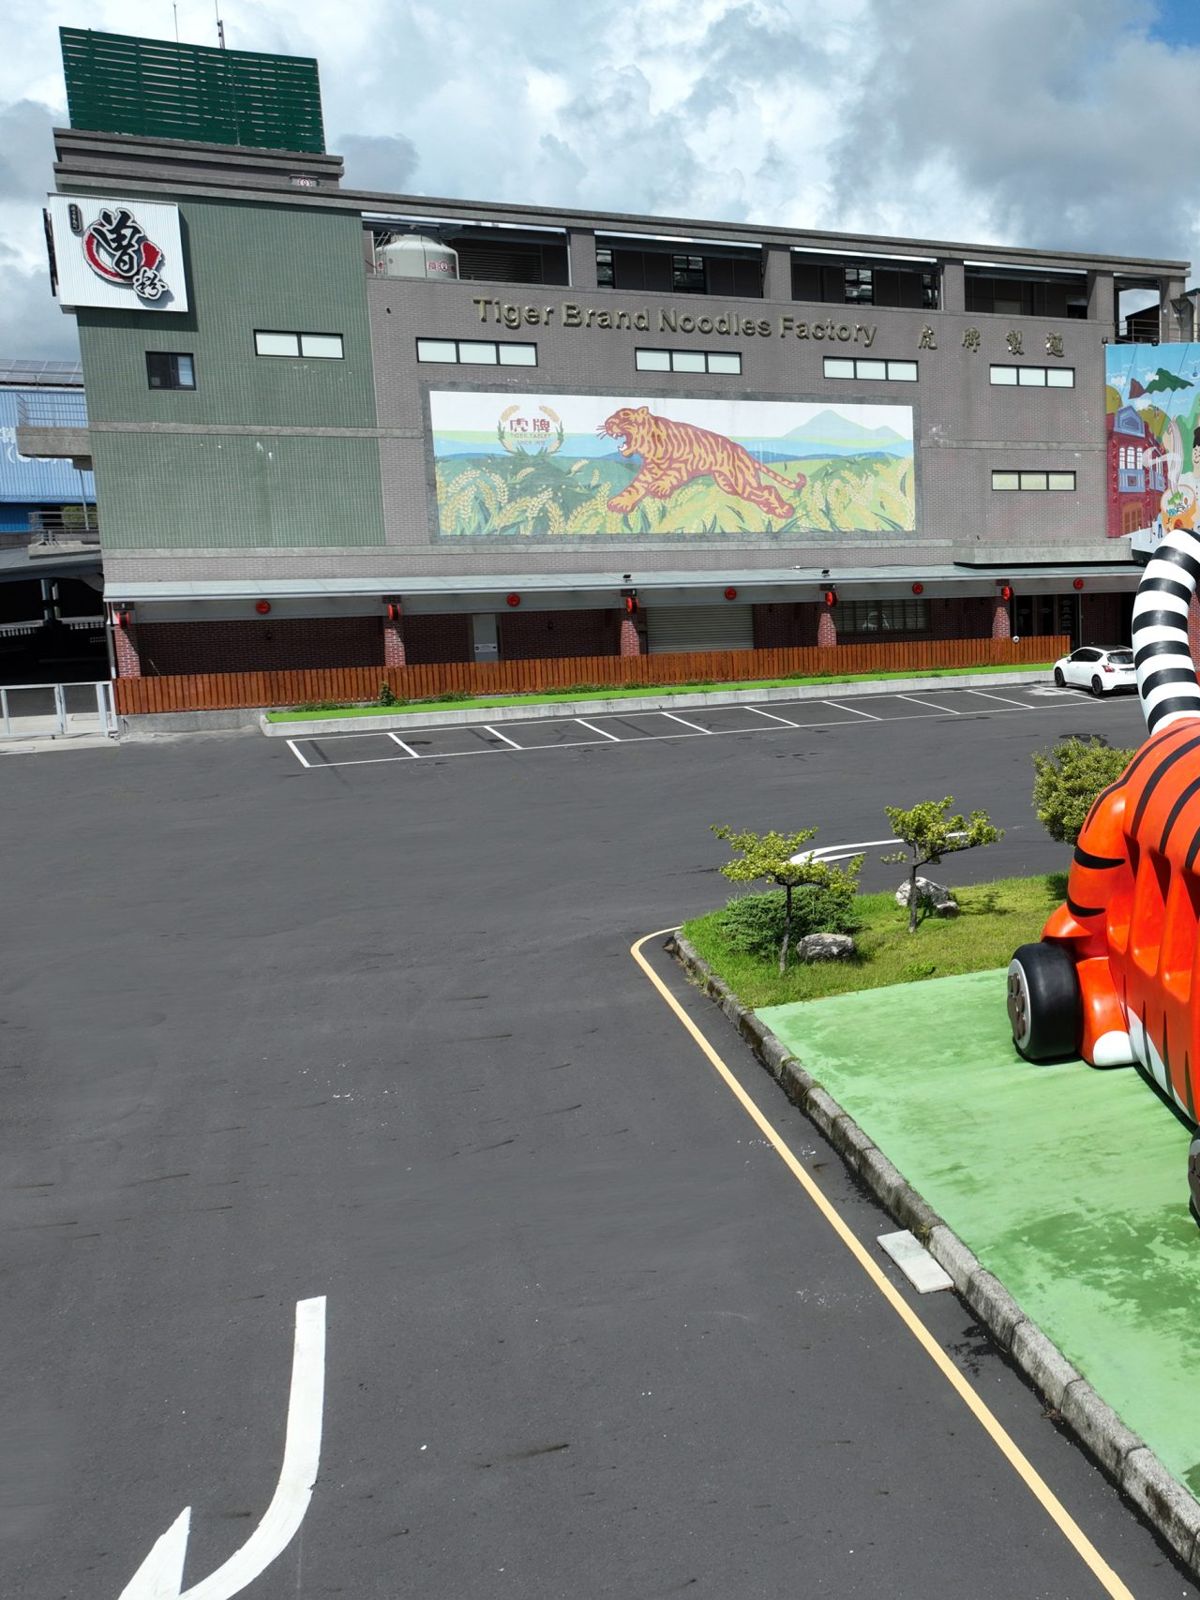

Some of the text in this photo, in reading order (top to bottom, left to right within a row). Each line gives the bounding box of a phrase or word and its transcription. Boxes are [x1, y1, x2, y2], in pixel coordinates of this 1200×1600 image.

[473, 298, 877, 348] Tiger Brand Noodles Factory
[510, 418, 550, 432] 虎牌
